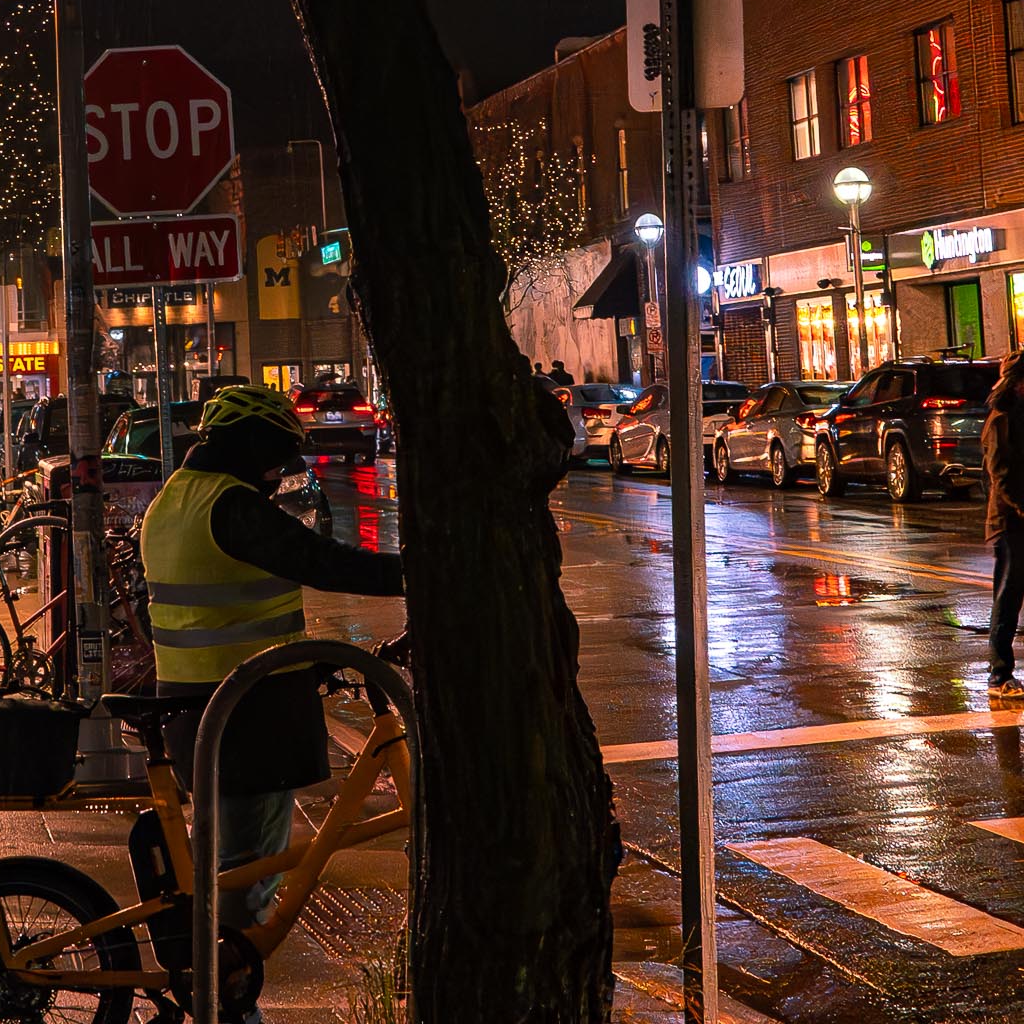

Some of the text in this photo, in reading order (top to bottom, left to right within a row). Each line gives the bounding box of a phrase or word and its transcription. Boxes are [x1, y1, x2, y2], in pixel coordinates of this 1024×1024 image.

[85, 98, 222, 163] STOP
[168, 229, 230, 269] WAY
[933, 226, 993, 264] Huntington
[112, 291, 193, 304] CHIPTLE
